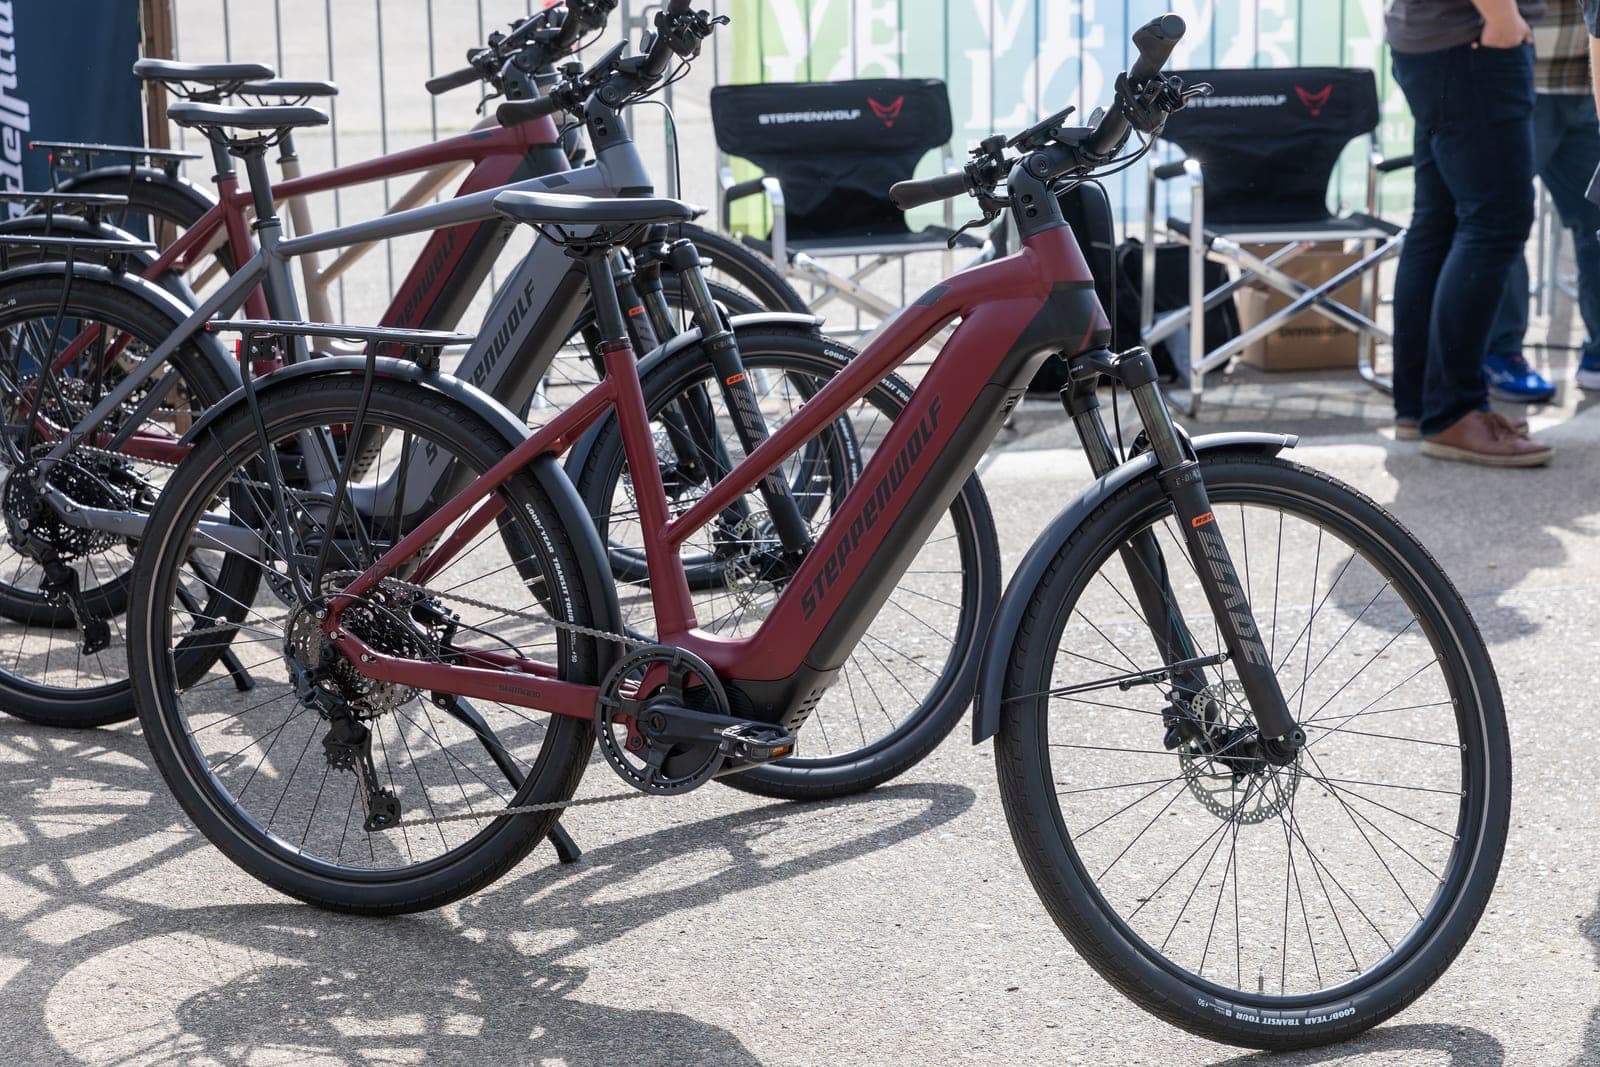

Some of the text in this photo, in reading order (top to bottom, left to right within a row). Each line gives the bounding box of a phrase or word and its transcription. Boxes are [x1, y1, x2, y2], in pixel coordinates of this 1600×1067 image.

[1187, 95, 1287, 108] STEPPENWOLF
[758, 109, 862, 125] STEPPENWOLF
[524, 502, 555, 554] GOODYEAR
[552, 556, 569, 595] TRANSIT
[564, 594, 575, 622] TOUR
[1236, 1012, 1260, 1024] TOUR
[1262, 1016, 1300, 1026] TRANSIT
[1304, 1007, 1356, 1025] GOODYEAR
